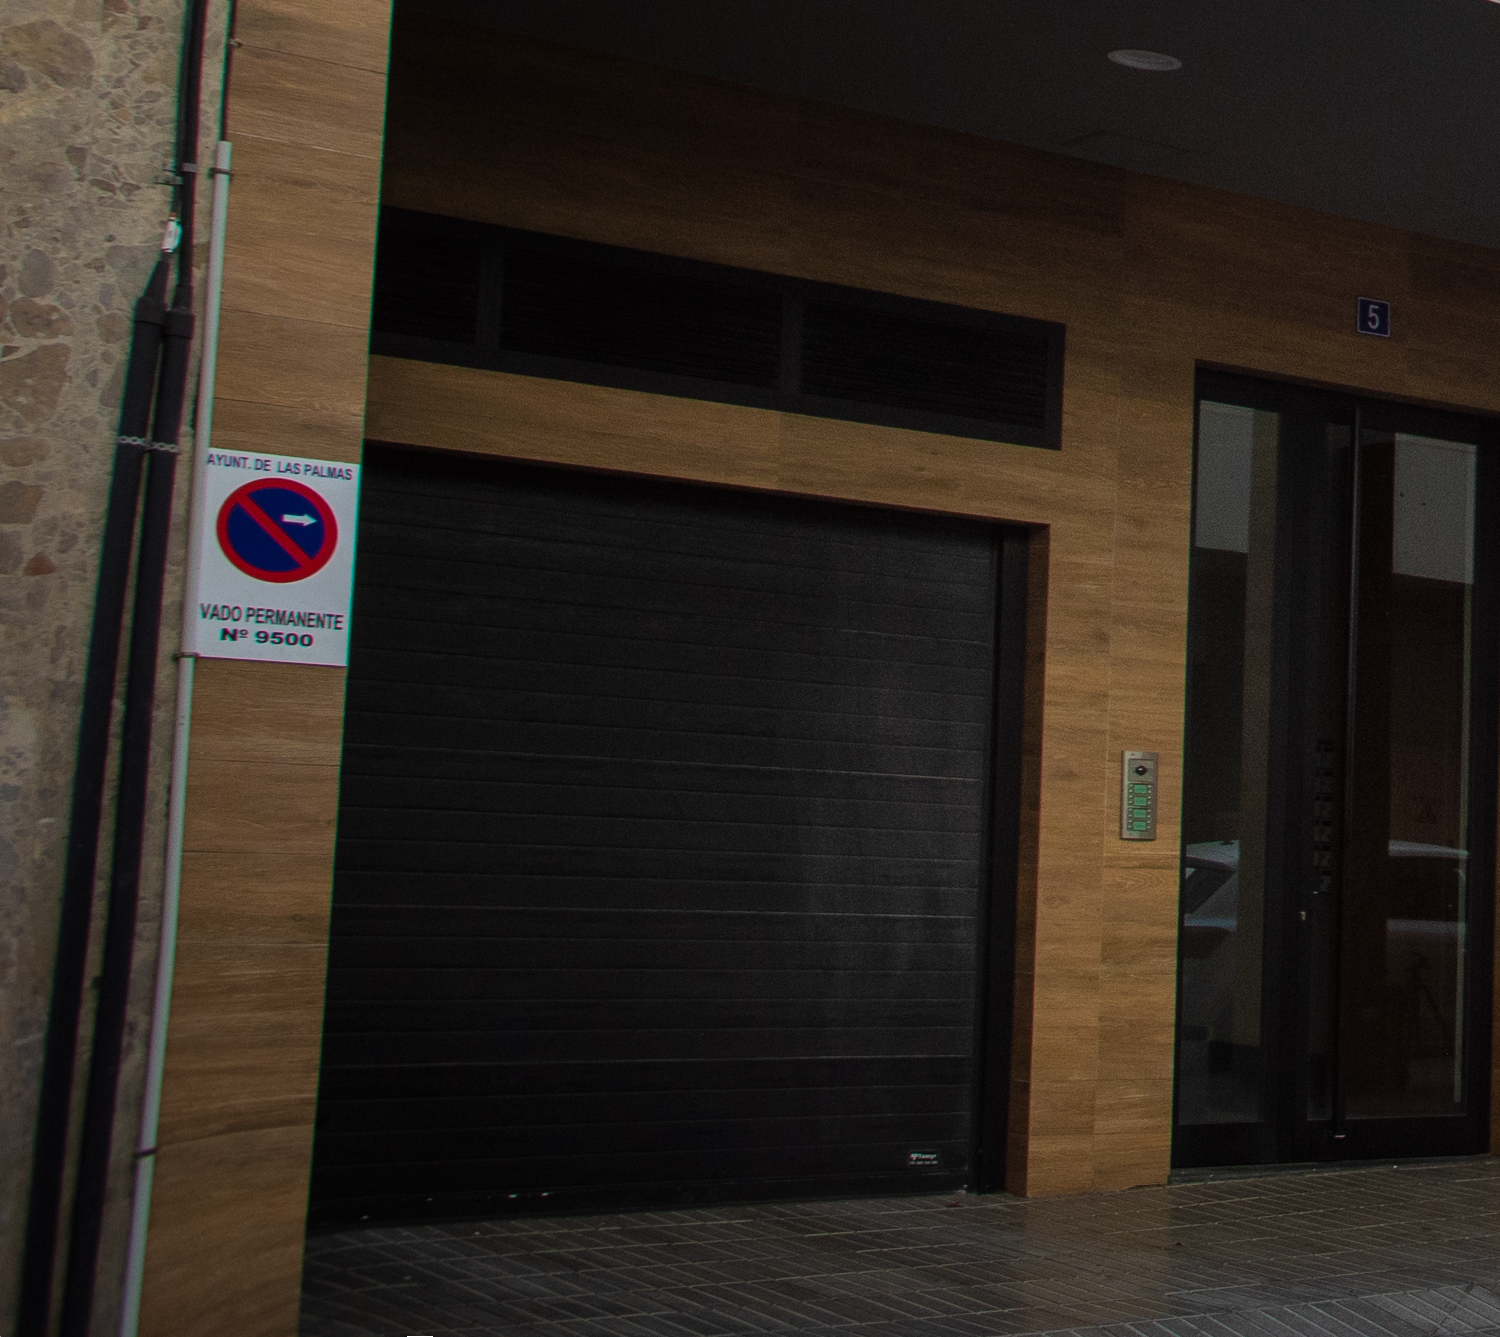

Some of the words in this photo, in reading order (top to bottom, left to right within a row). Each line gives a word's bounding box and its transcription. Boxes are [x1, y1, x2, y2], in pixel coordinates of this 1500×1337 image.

[1368, 305, 1380, 329] 5
[207, 453, 251, 469] AYUNT.
[255, 458, 272, 471] DE
[278, 461, 301, 475] LAS
[304, 464, 353, 481] PALMAS
[200, 603, 242, 622] VADO
[246, 607, 344, 630] PERMANENTE
[220, 628, 248, 641] Nº
[256, 630, 314, 647] 9500
